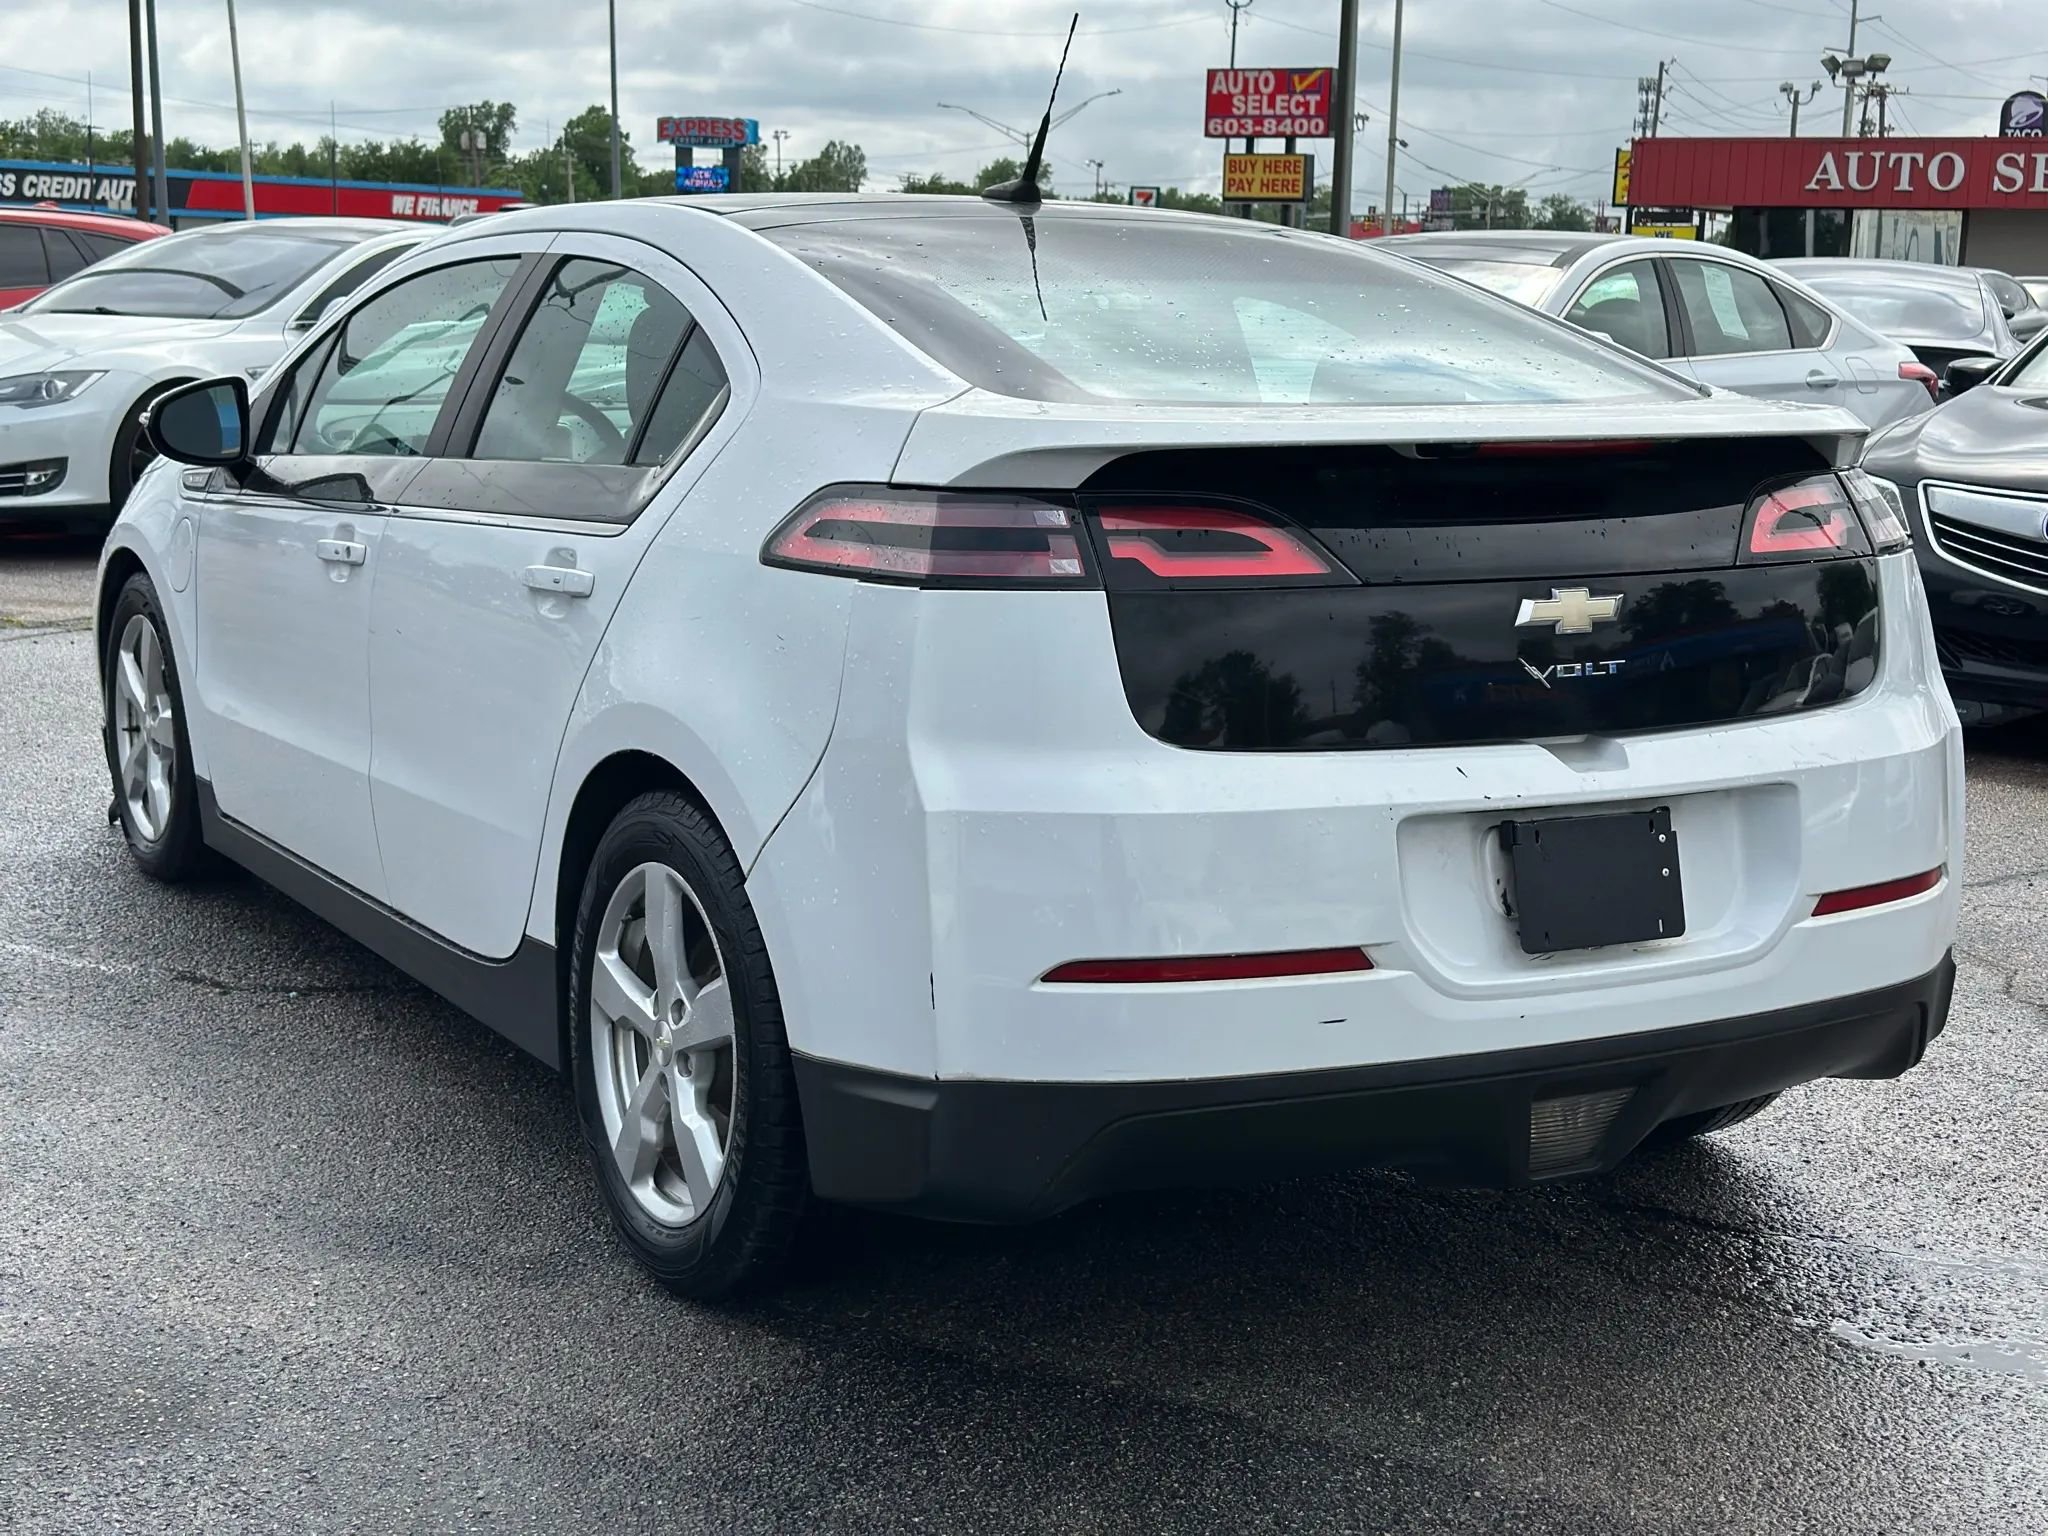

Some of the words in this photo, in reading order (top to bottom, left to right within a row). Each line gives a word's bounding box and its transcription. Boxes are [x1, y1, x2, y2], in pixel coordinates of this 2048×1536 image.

[1211, 70, 1275, 95] AUTO
[1231, 94, 1321, 116] SELECT
[659, 118, 746, 141] EXPRESS
[1207, 117, 1325, 136] 603-8400
[1228, 159, 1258, 174] BUY
[1263, 160, 1301, 175] HERE
[1805, 151, 1966, 192] AUTO
[22, 174, 97, 200] CREDIT
[96, 178, 138, 202] AUT
[1228, 178, 1255, 192] PAY
[1260, 179, 1300, 193] HERE
[392, 195, 416, 215] WE
[416, 196, 479, 216] FINANCE
[1518, 657, 1626, 688] VOLT
